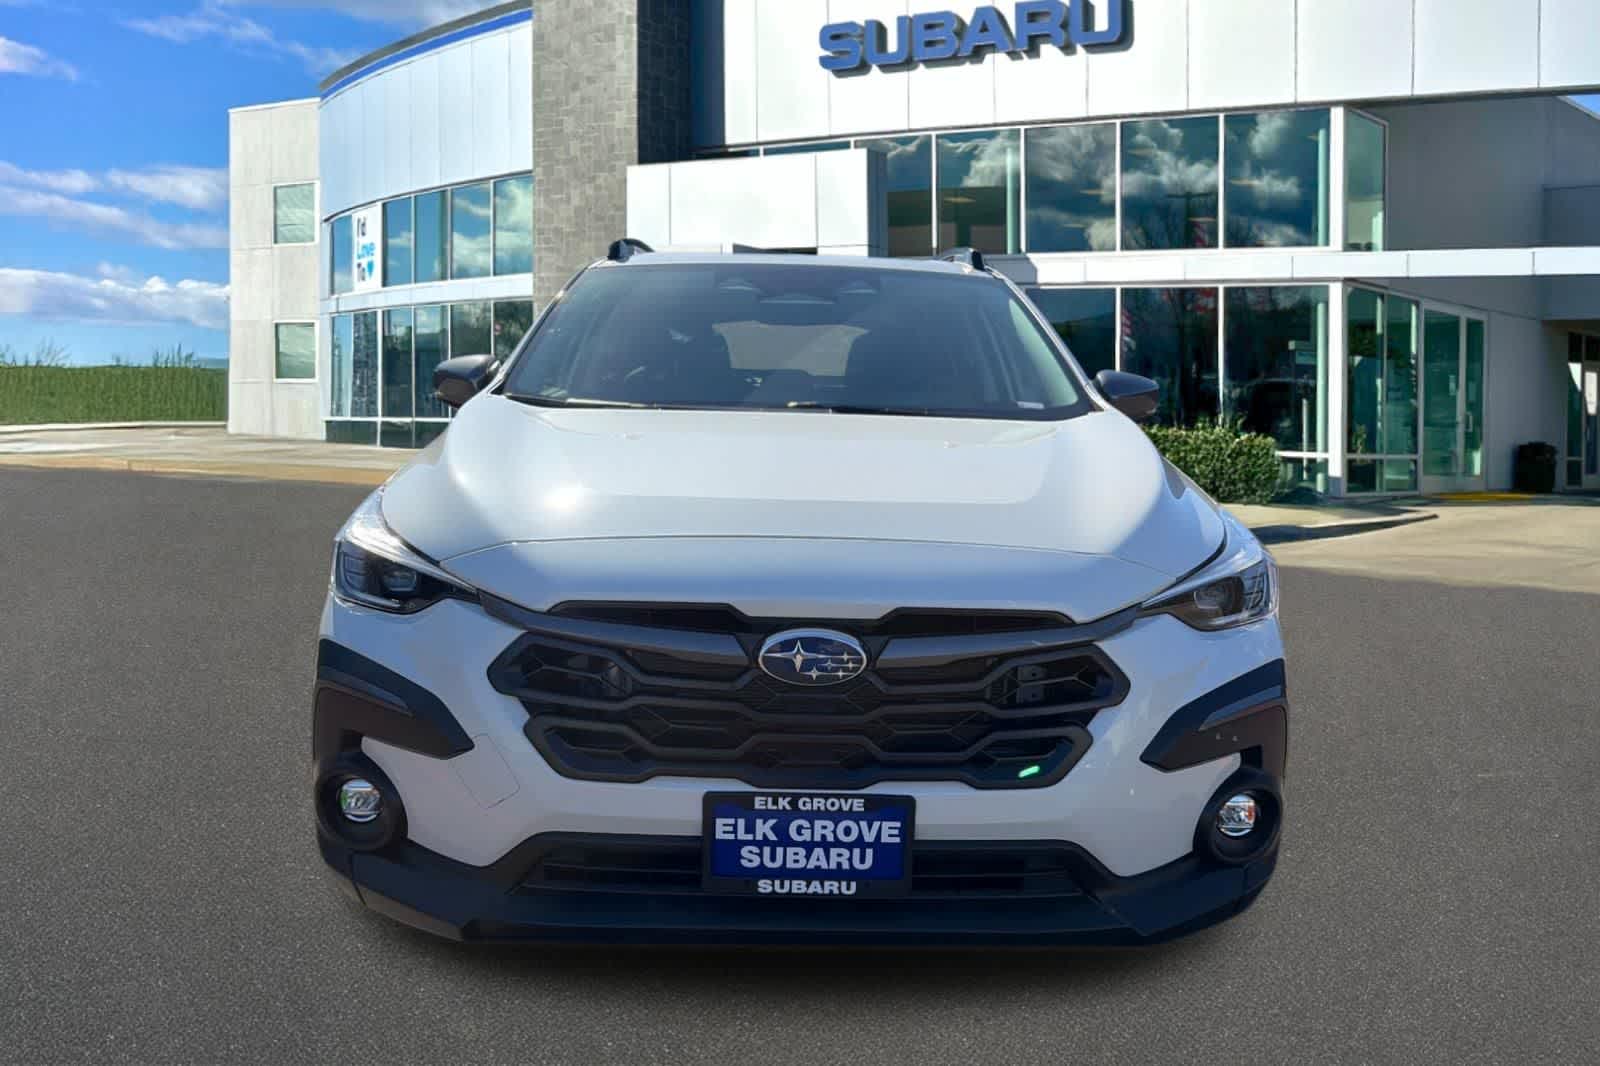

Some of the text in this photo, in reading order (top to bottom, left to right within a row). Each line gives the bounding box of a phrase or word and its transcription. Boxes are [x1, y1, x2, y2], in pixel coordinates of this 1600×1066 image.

[819, 0, 1130, 75] SUBARU
[754, 797, 865, 812] ELK GROVE
[715, 818, 901, 843] ELK GROVE
[740, 846, 874, 870] SUBARU
[757, 879, 857, 895] SUBARU
